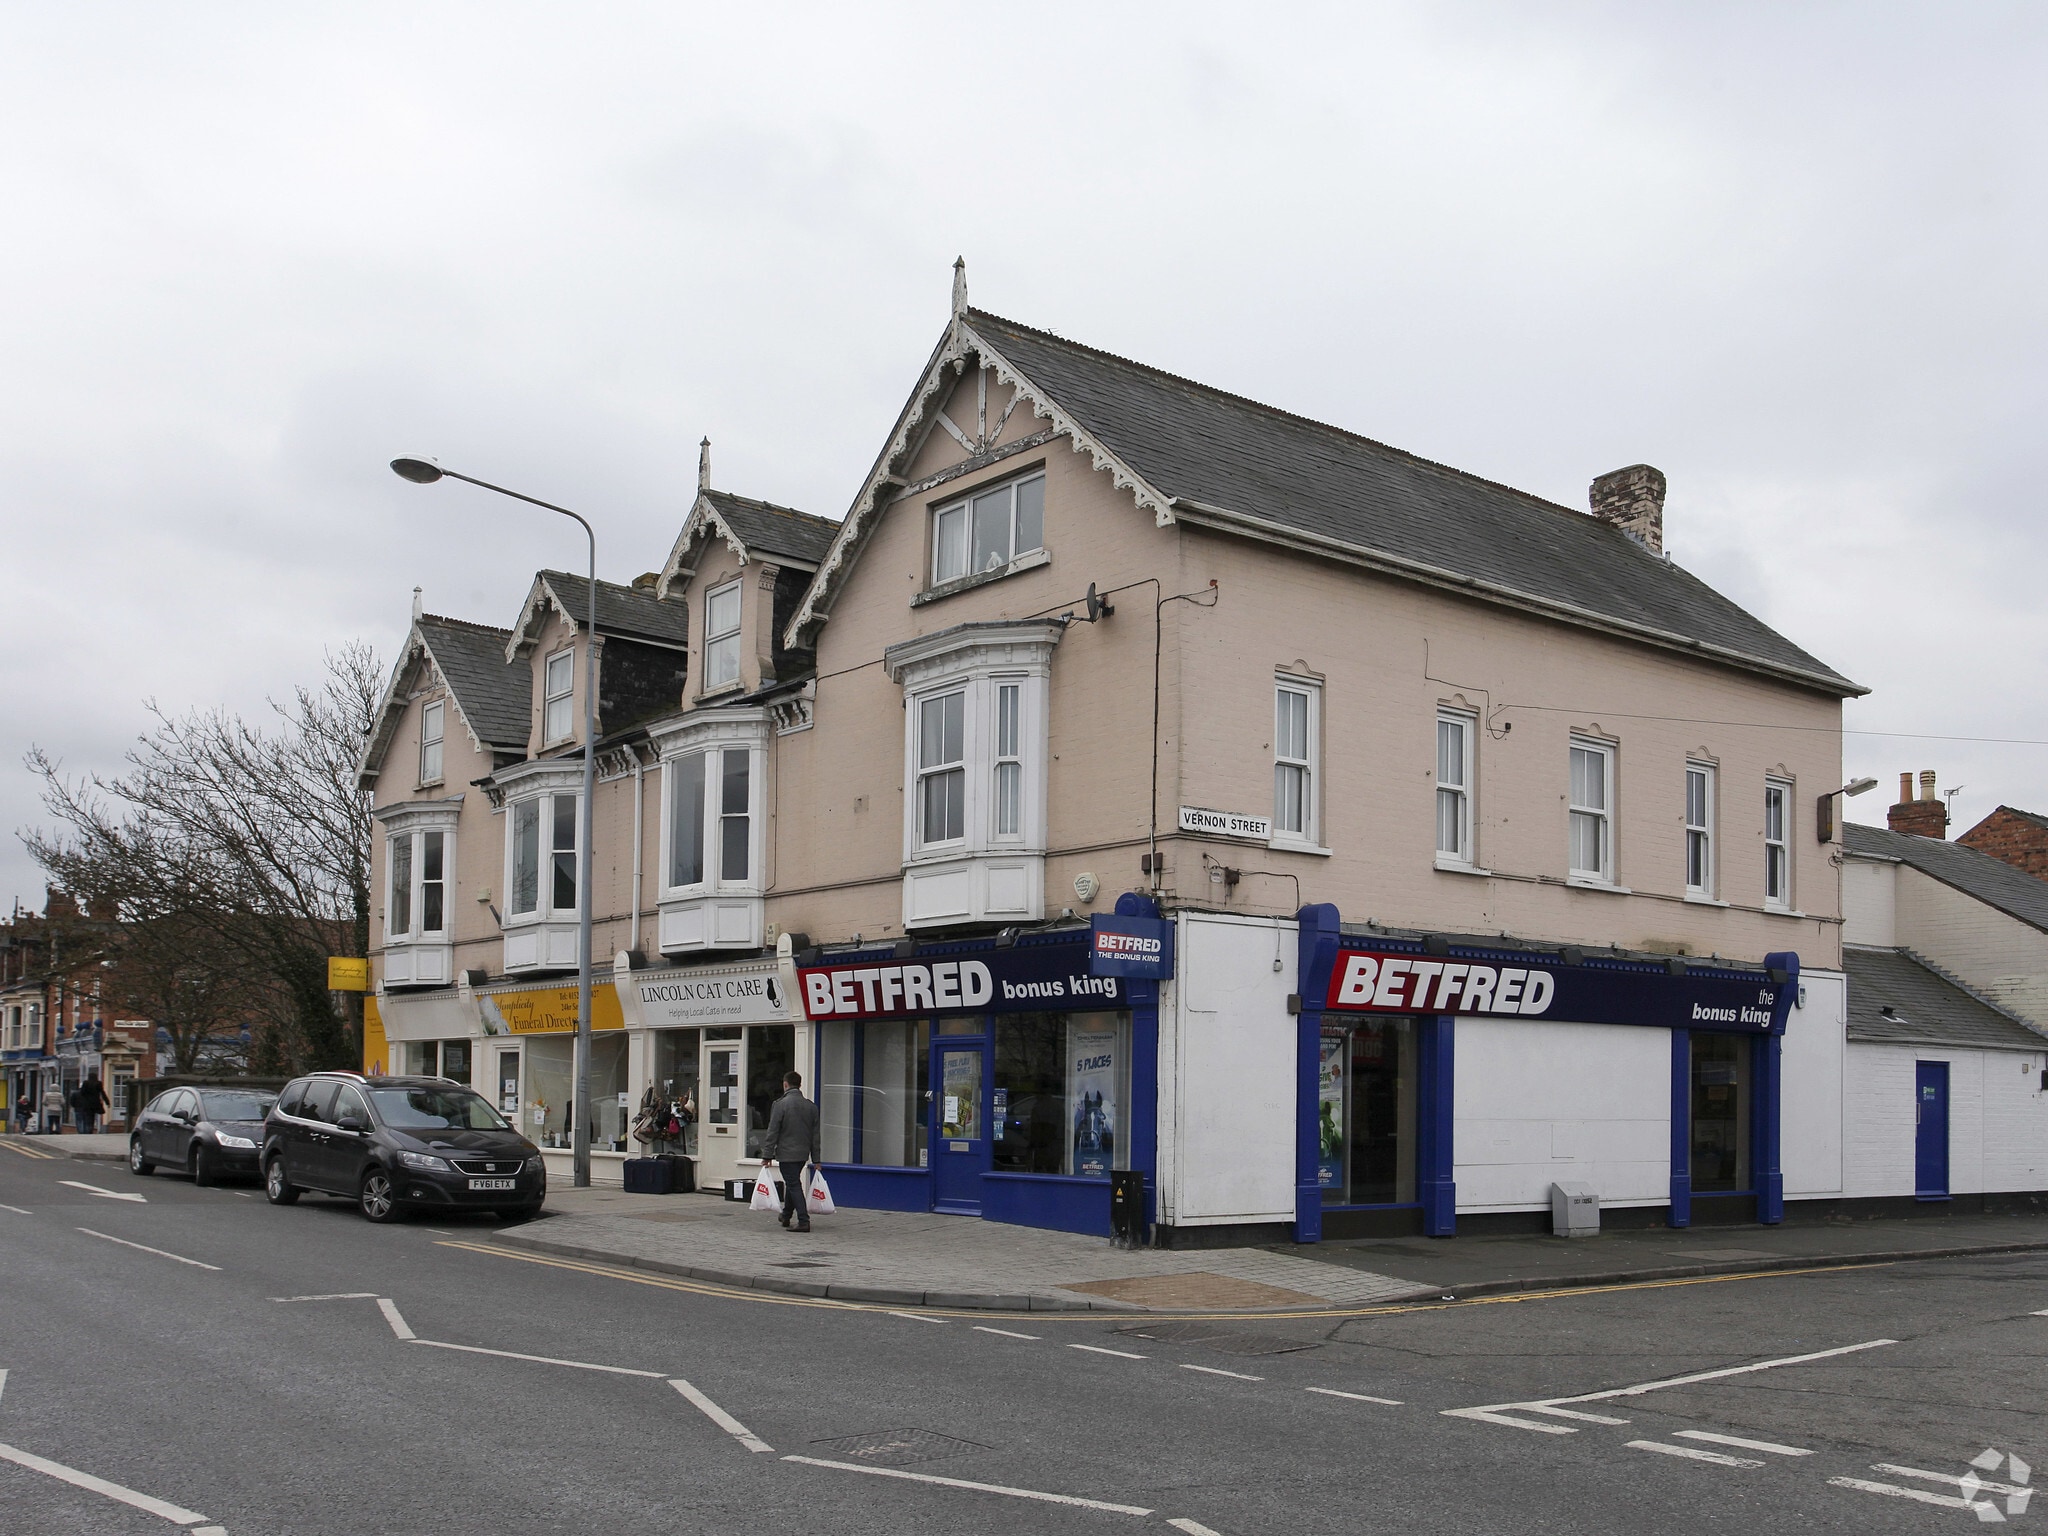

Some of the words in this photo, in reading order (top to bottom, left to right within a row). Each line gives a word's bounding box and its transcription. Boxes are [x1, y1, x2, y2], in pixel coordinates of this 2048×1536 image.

[1184, 812, 1226, 828] VERNON
[1231, 818, 1267, 833] STREET
[1098, 934, 1161, 952] BETFRED
[1098, 951, 1112, 959] THE
[1114, 952, 1141, 961] BONUS
[1142, 954, 1160, 963] KING
[641, 984, 694, 1003] LINCOLN
[696, 982, 722, 999] CAT
[726, 978, 763, 997] CARE
[805, 960, 994, 1015] BETFRED
[1002, 978, 1064, 999] bonus
[1069, 974, 1117, 998] king
[1337, 955, 1555, 1015] BETFRED
[1759, 988, 1774, 1005] the
[494, 995, 534, 1020] Simplicity
[668, 1006, 689, 1019] Helping
[689, 1006, 704, 1017] Local
[705, 1005, 720, 1016] Cats
[721, 1005, 726, 1014] in
[727, 1004, 741, 1015] need
[1692, 1003, 1736, 1021] bonus
[1740, 1005, 1771, 1027] king
[513, 1014, 543, 1029] Funeral
[545, 1012, 579, 1028] Directo
[1077, 1059, 1083, 1072] 5
[1084, 1054, 1112, 1071] PLACES
[474, 1180, 493, 1188] FV61
[495, 1180, 511, 1188] ETX
